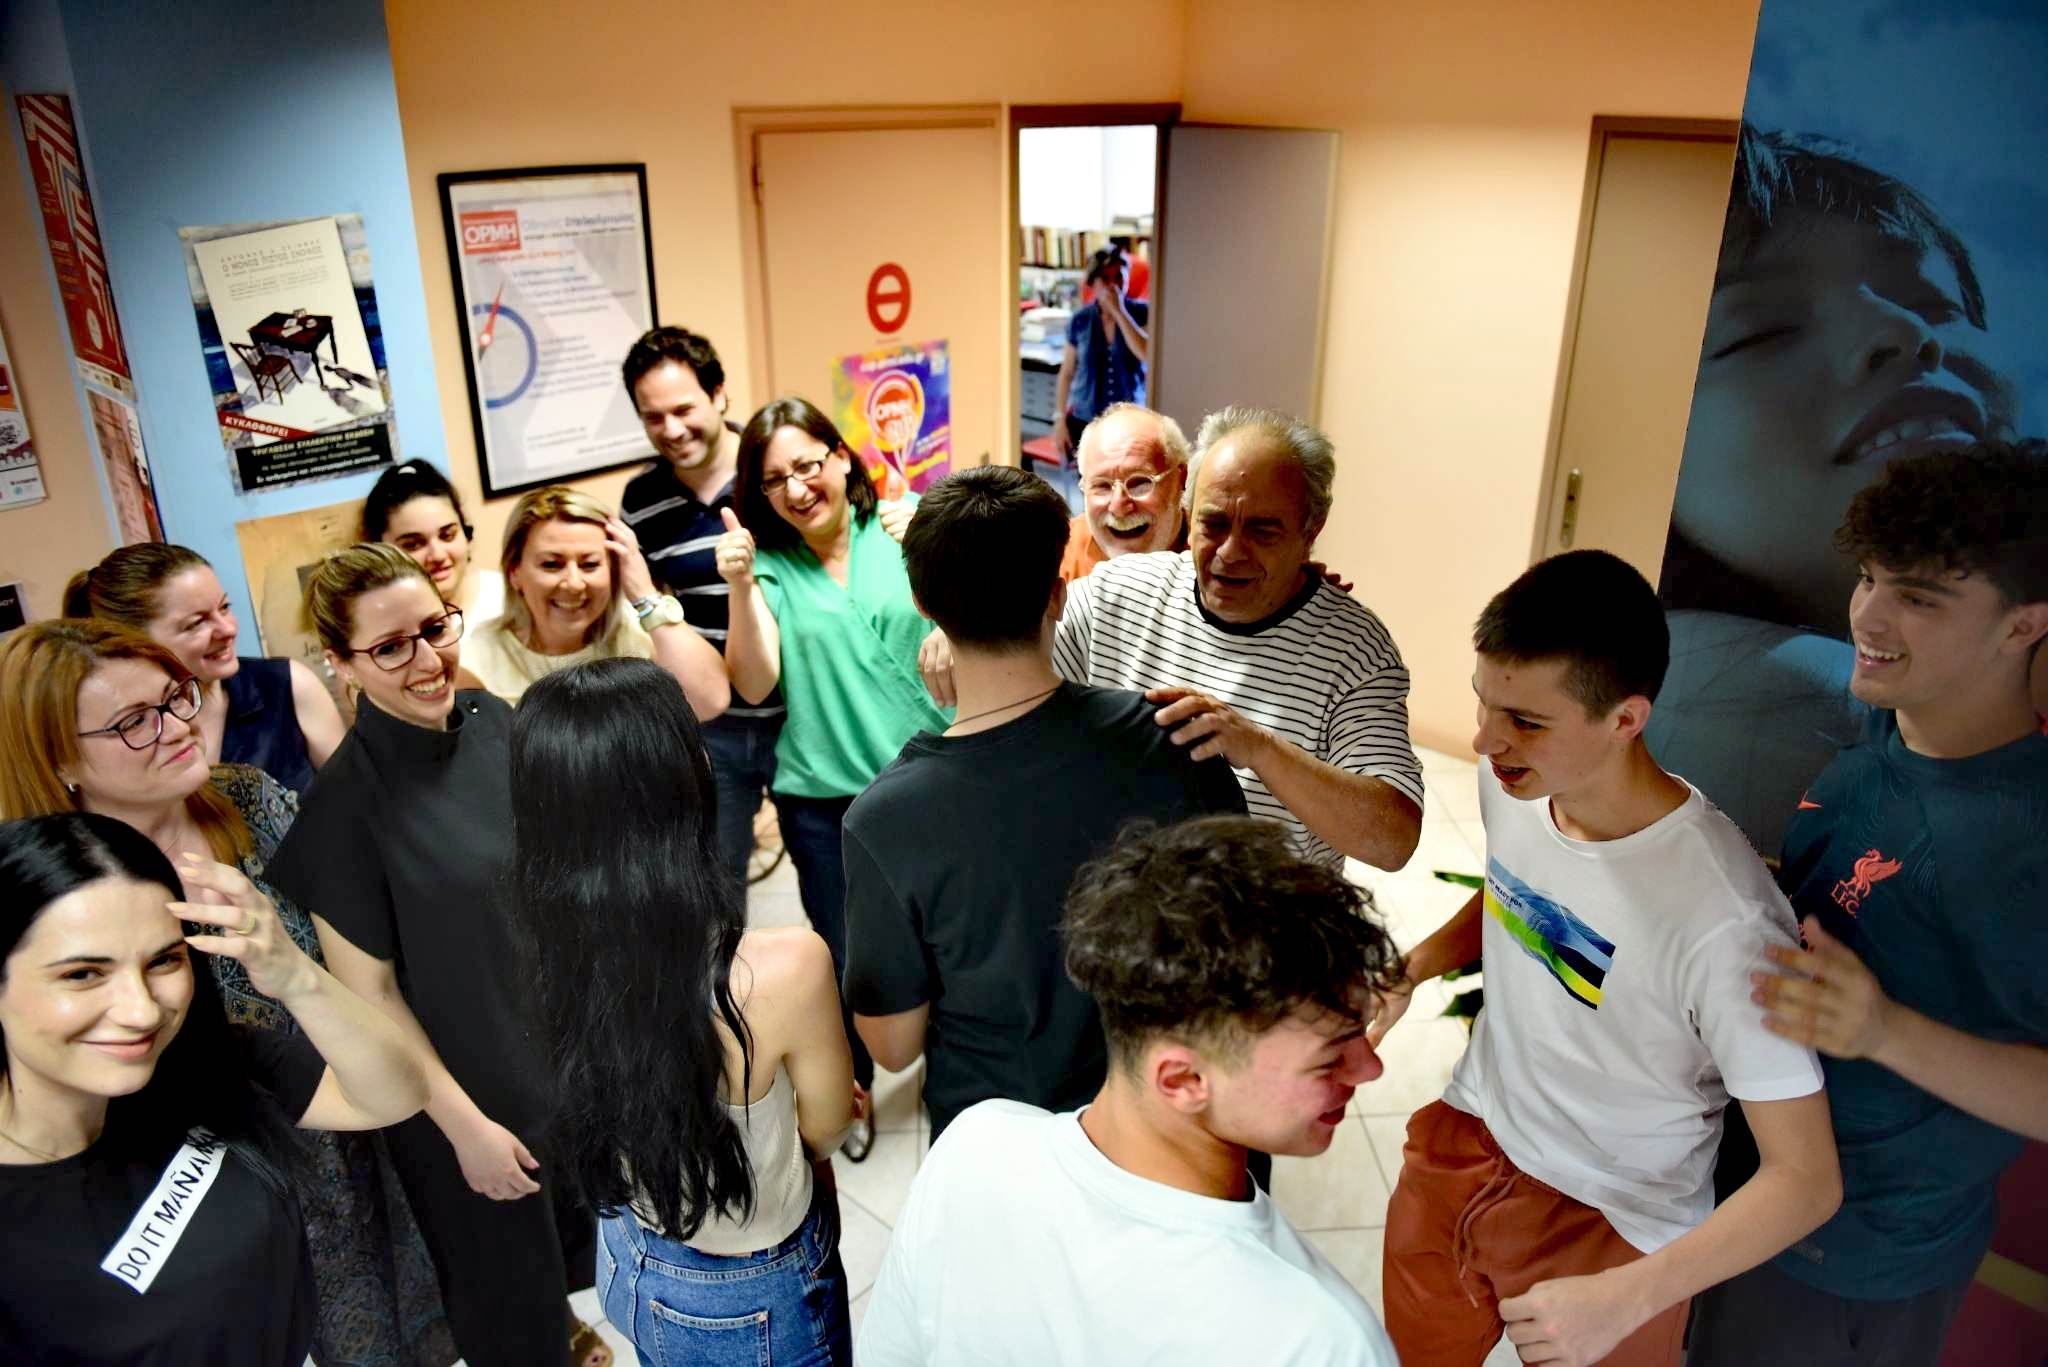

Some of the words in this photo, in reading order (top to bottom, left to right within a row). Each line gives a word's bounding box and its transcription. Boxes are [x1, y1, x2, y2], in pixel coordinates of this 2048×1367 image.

[464, 222, 517, 244] ΟΡΜΗ
[225, 416, 288, 438] ΚΥΚΛΟΦΟΡΕΙ
[116, 1247, 151, 1281] DO
[140, 1222, 166, 1248] IT
